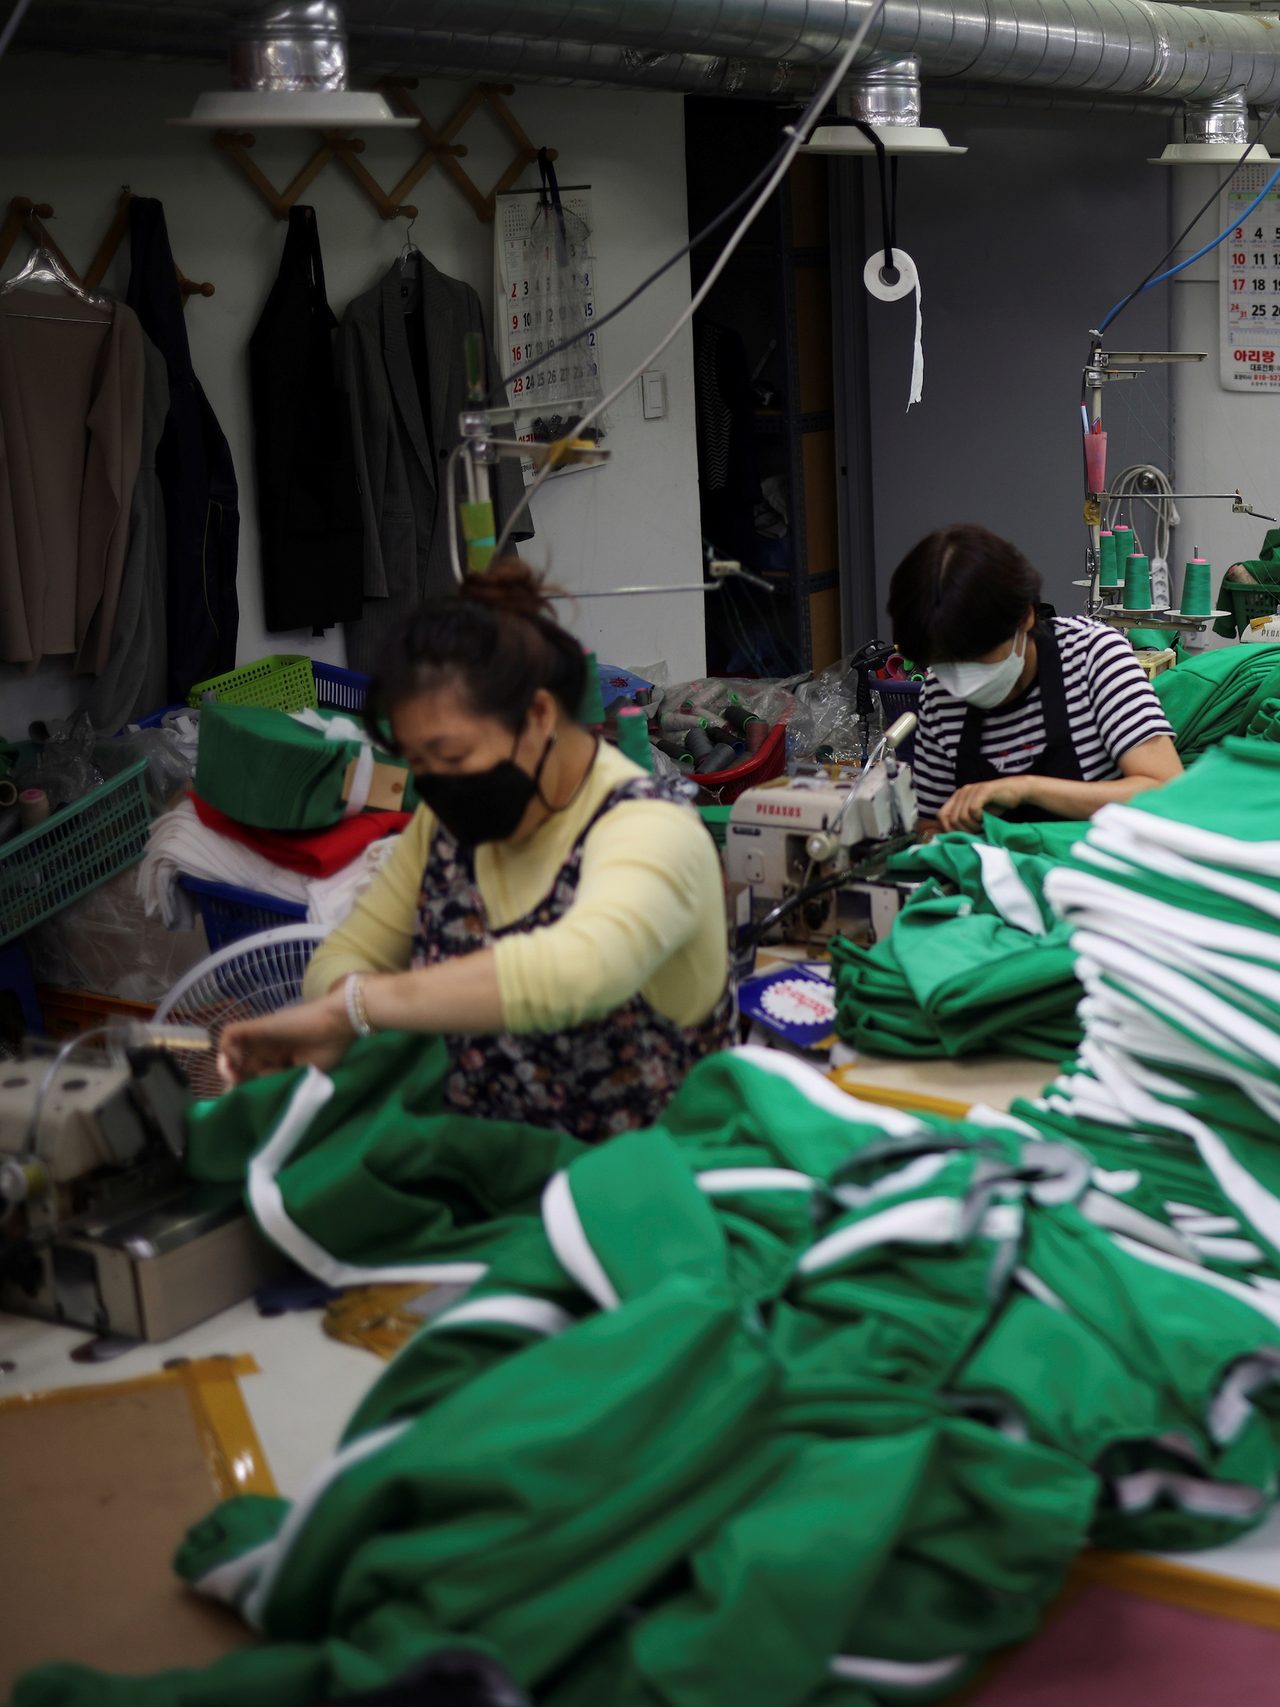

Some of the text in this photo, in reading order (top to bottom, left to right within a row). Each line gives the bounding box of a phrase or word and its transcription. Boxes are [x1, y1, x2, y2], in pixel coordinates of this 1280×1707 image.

[1235, 228, 1243, 239] 3
[1254, 228, 1263, 239] 4
[1232, 253, 1245, 265] 10
[1253, 254, 1265, 265] 11
[524, 281, 529, 295] 3
[1232, 279, 1245, 291] 17
[1253, 279, 1265, 291] 18
[512, 316, 518, 329] 9
[524, 313, 531, 327] 10
[585, 303, 593, 316] 15
[1252, 305, 1266, 317] 25
[512, 346, 521, 361] 16
[525, 344, 532, 358] 17
[1234, 351, 1275, 362] 아리랑
[513, 378, 523, 393] 23
[526, 375, 535, 389] 24
[757, 803, 802, 817] PEGASUS
